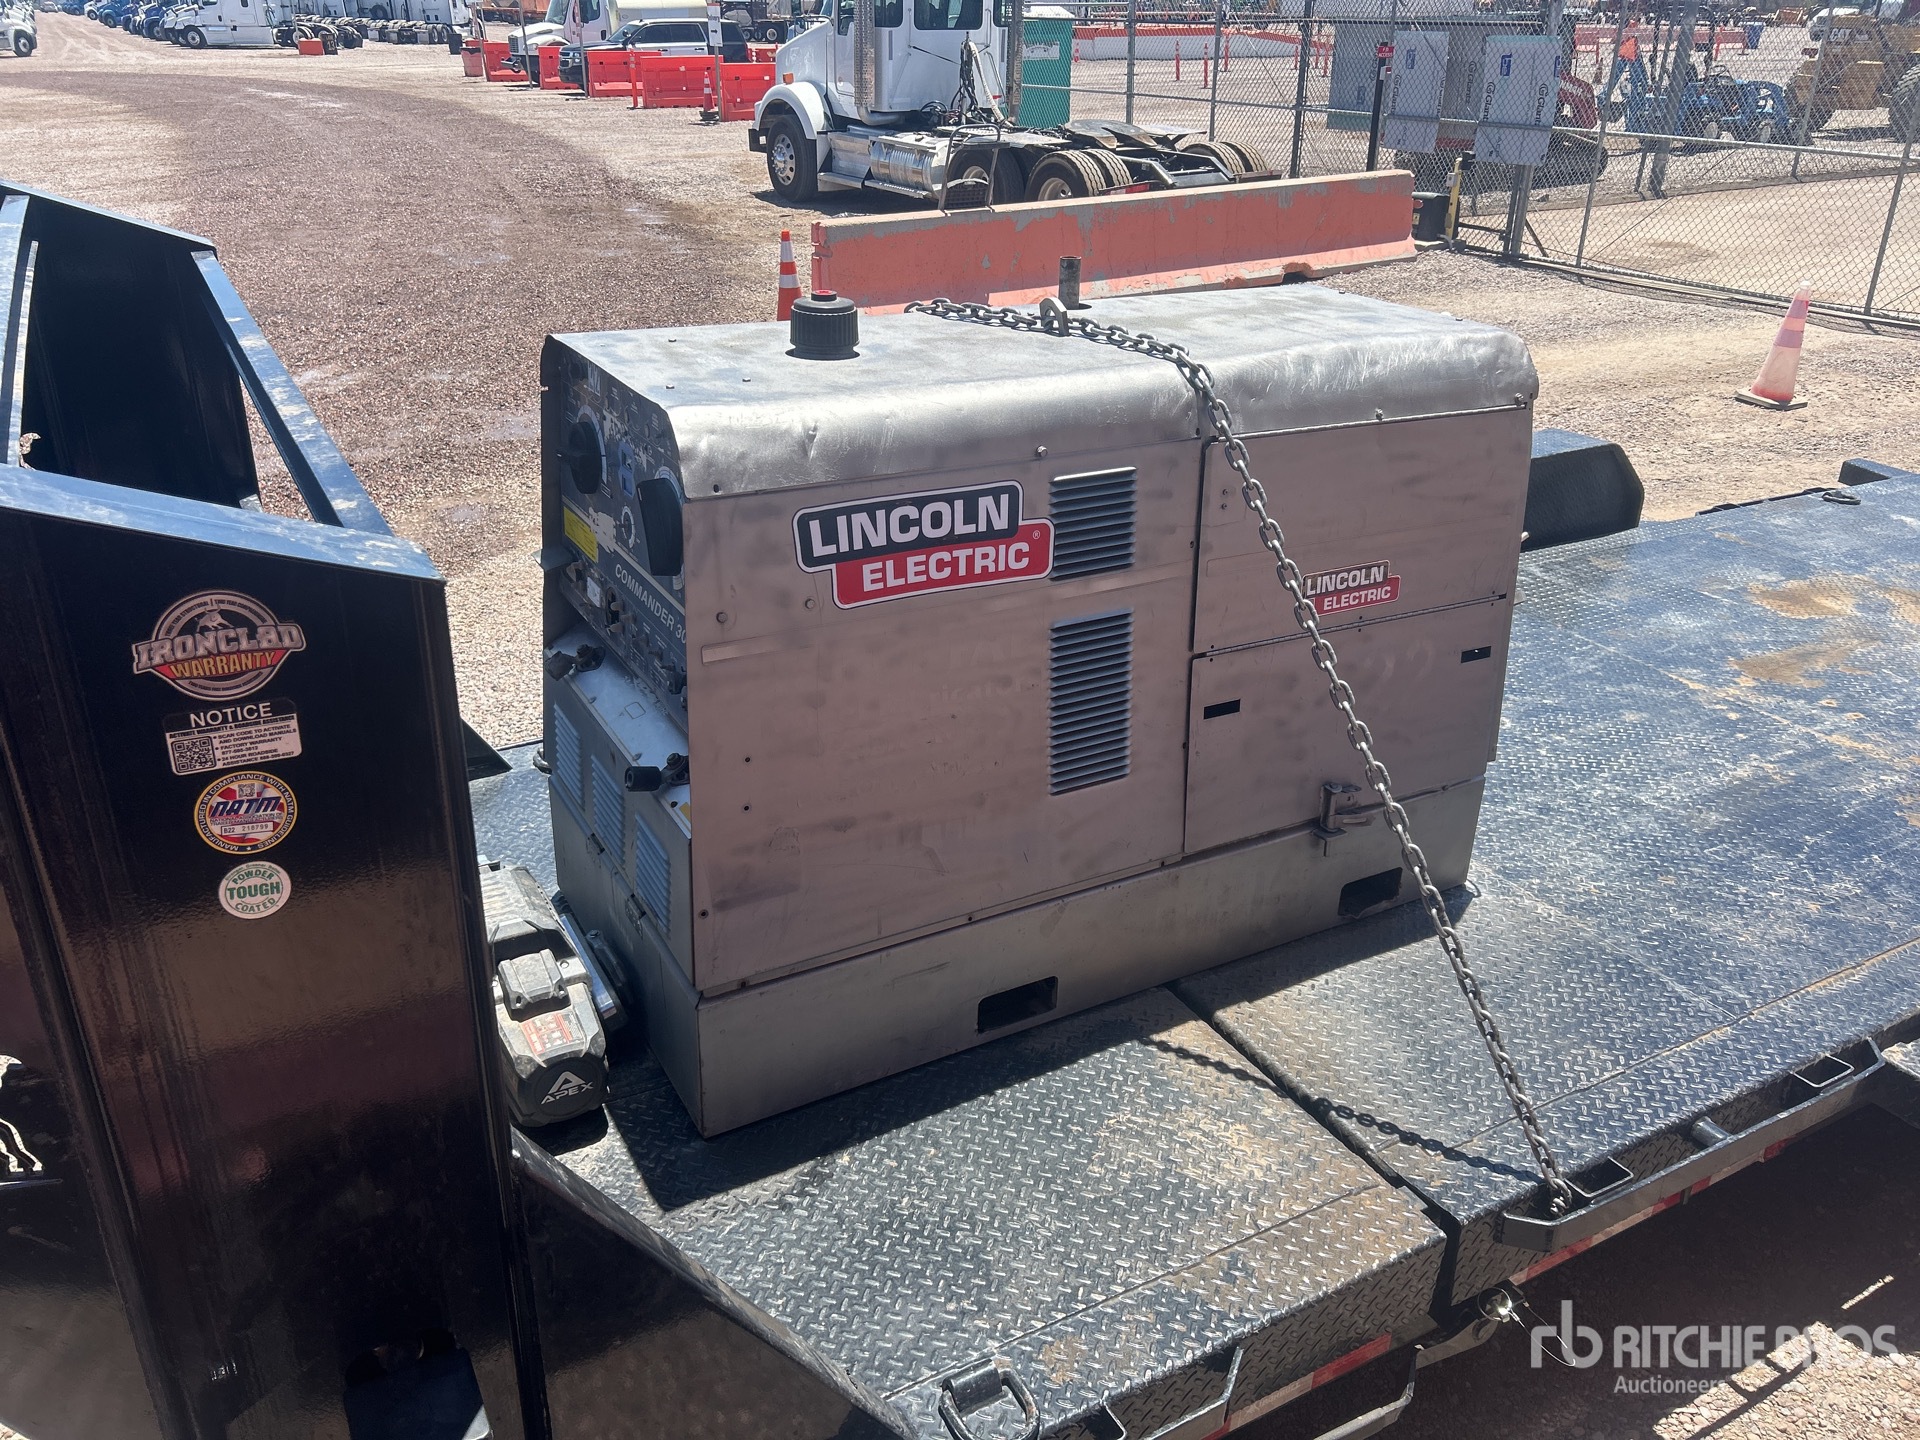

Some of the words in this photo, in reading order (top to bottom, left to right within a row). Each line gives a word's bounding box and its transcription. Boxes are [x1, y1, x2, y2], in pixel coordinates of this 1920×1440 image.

[809, 493, 1009, 557] LINCOLN
[862, 541, 1030, 592] ELECTRIC
[1306, 565, 1385, 597] LINCOLN
[615, 564, 675, 631] COMMANDER
[1323, 586, 1391, 611] ELECTRIC
[138, 624, 303, 670] IRONCLAD
[169, 651, 276, 678] WARRANTY
[189, 702, 273, 728] NOTICE
[196, 725, 228, 735] WARRANTY
[234, 720, 262, 729] ROADSIDE
[263, 715, 295, 725] ASSISTANCE
[217, 732, 235, 740] SCAN
[235, 729, 253, 737] CODE
[263, 724, 291, 733] ACTIVATE
[233, 733, 268, 743] DOWNLOAD
[268, 728, 297, 737] MANUALS
[220, 742, 248, 751] FACTORY
[248, 736, 282, 746] WARRANTY
[230, 753, 248, 761] HOUR
[248, 748, 279, 758] ROADSIDE
[222, 757, 259, 767] ASSISTANCE
[210, 774, 266, 795] COMPLIANCE
[266, 777, 286, 792] WITH
[203, 796, 211, 805] IN
[210, 796, 282, 818] NATM
[283, 791, 295, 814] NATM
[199, 805, 239, 851] MANUFACTURED
[257, 814, 293, 849] GUIDELINES
[232, 869, 275, 885] POWDER
[227, 881, 281, 900] TOUGH
[235, 897, 276, 913] COATED
[541, 1081, 594, 1105] APEX
